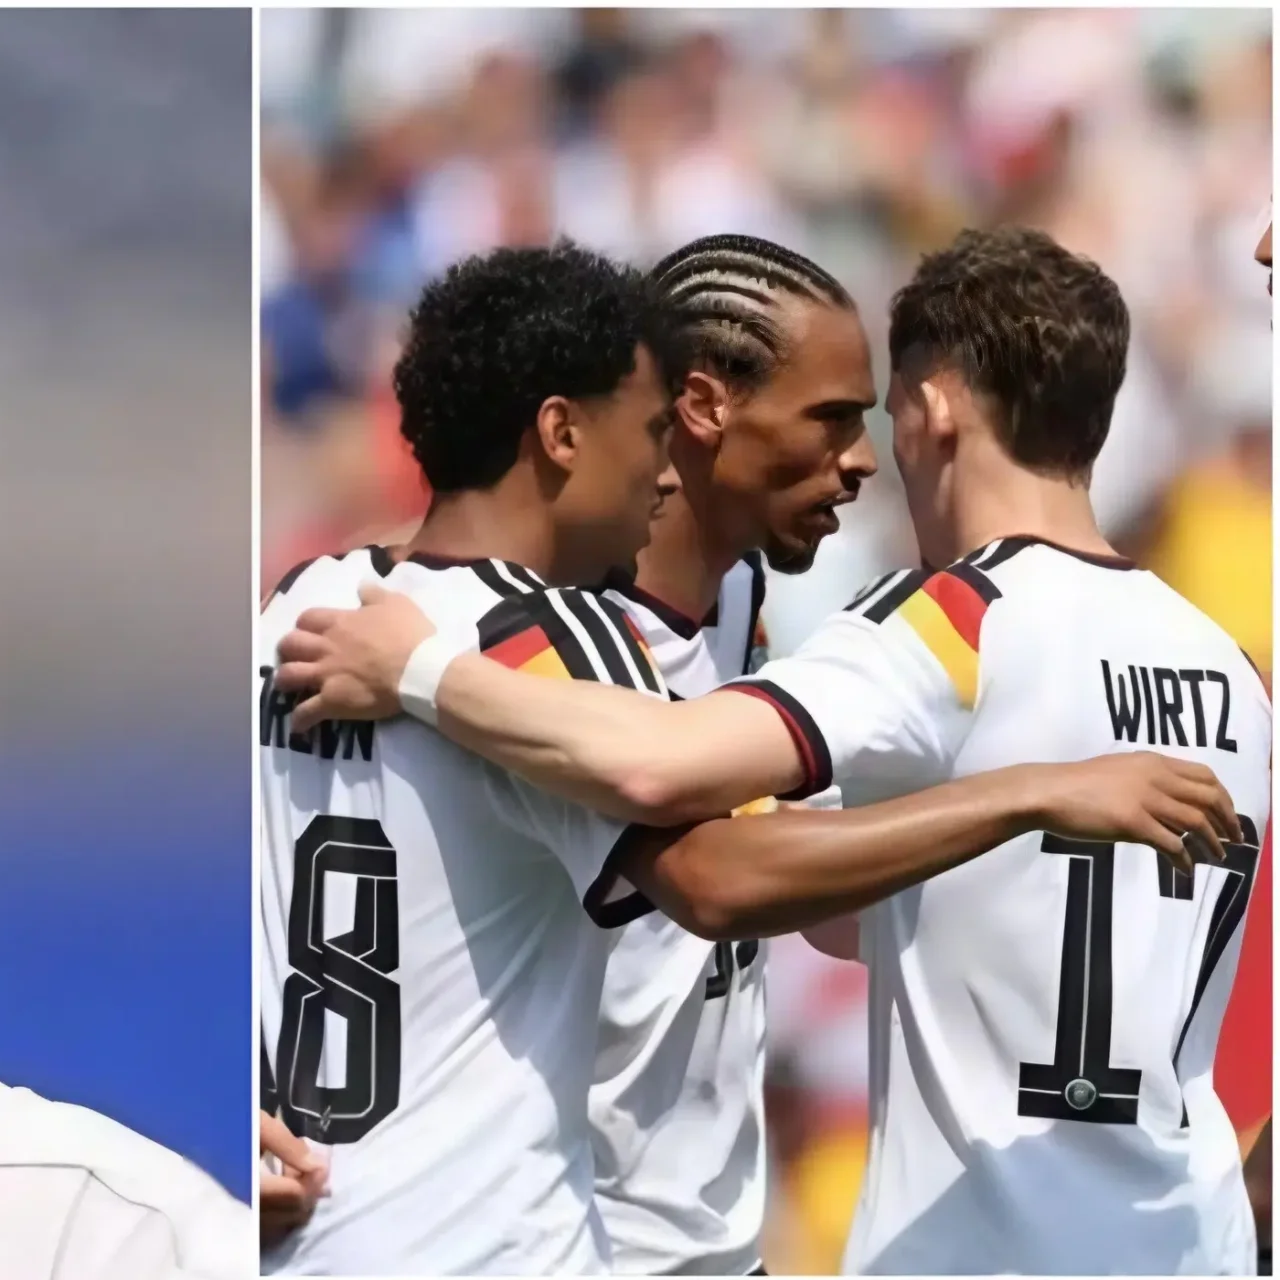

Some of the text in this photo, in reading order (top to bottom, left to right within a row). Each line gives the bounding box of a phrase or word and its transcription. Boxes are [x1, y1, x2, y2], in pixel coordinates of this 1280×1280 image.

[1100, 659, 1238, 753] WIRTZ
[261, 814, 402, 1145] 8
[1017, 812, 1260, 1130] 17
